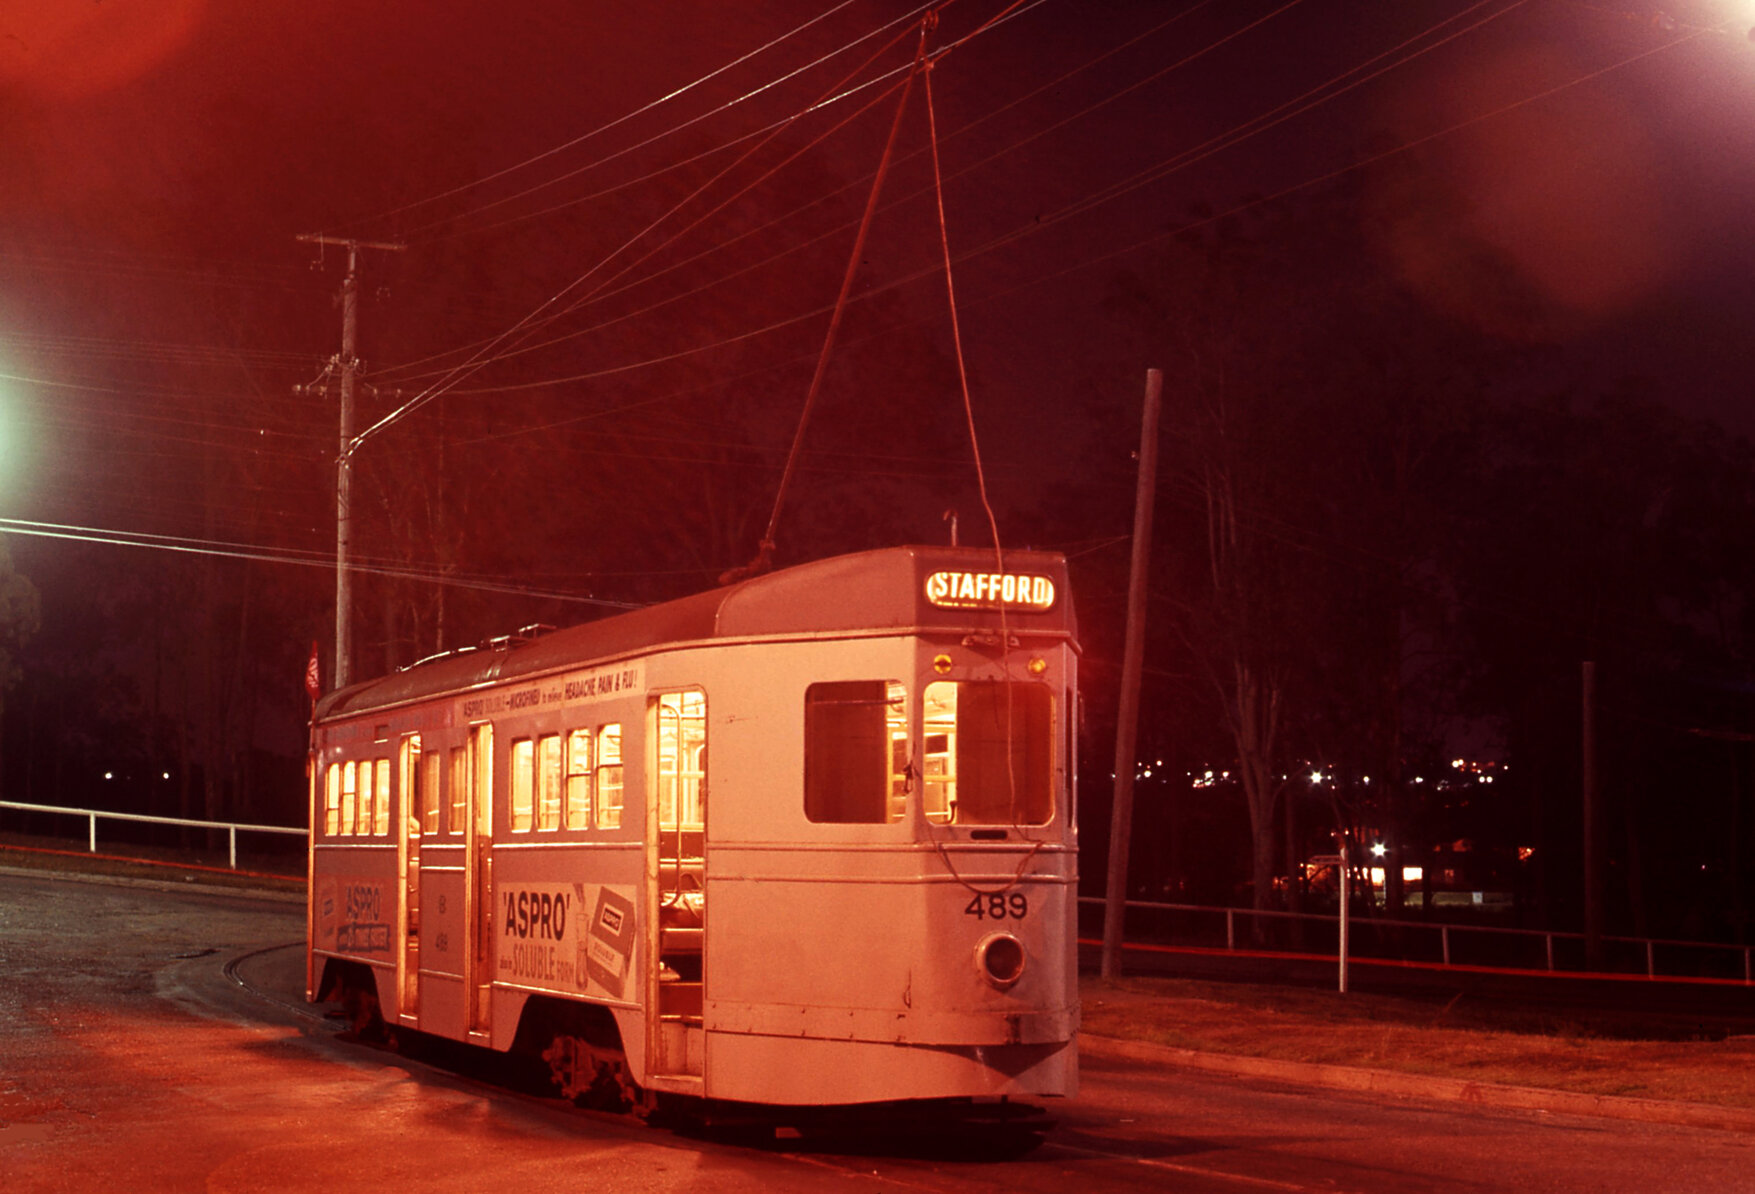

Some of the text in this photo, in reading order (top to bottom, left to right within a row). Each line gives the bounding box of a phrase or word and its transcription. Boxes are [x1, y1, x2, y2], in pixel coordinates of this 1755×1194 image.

[935, 572, 1046, 604] STAFFORD
[598, 674, 614, 694] PAIN
[615, 672, 620, 692] &
[965, 892, 1028, 920] 489
[513, 943, 555, 981] SOLUBLE
[556, 959, 574, 984] FORM
